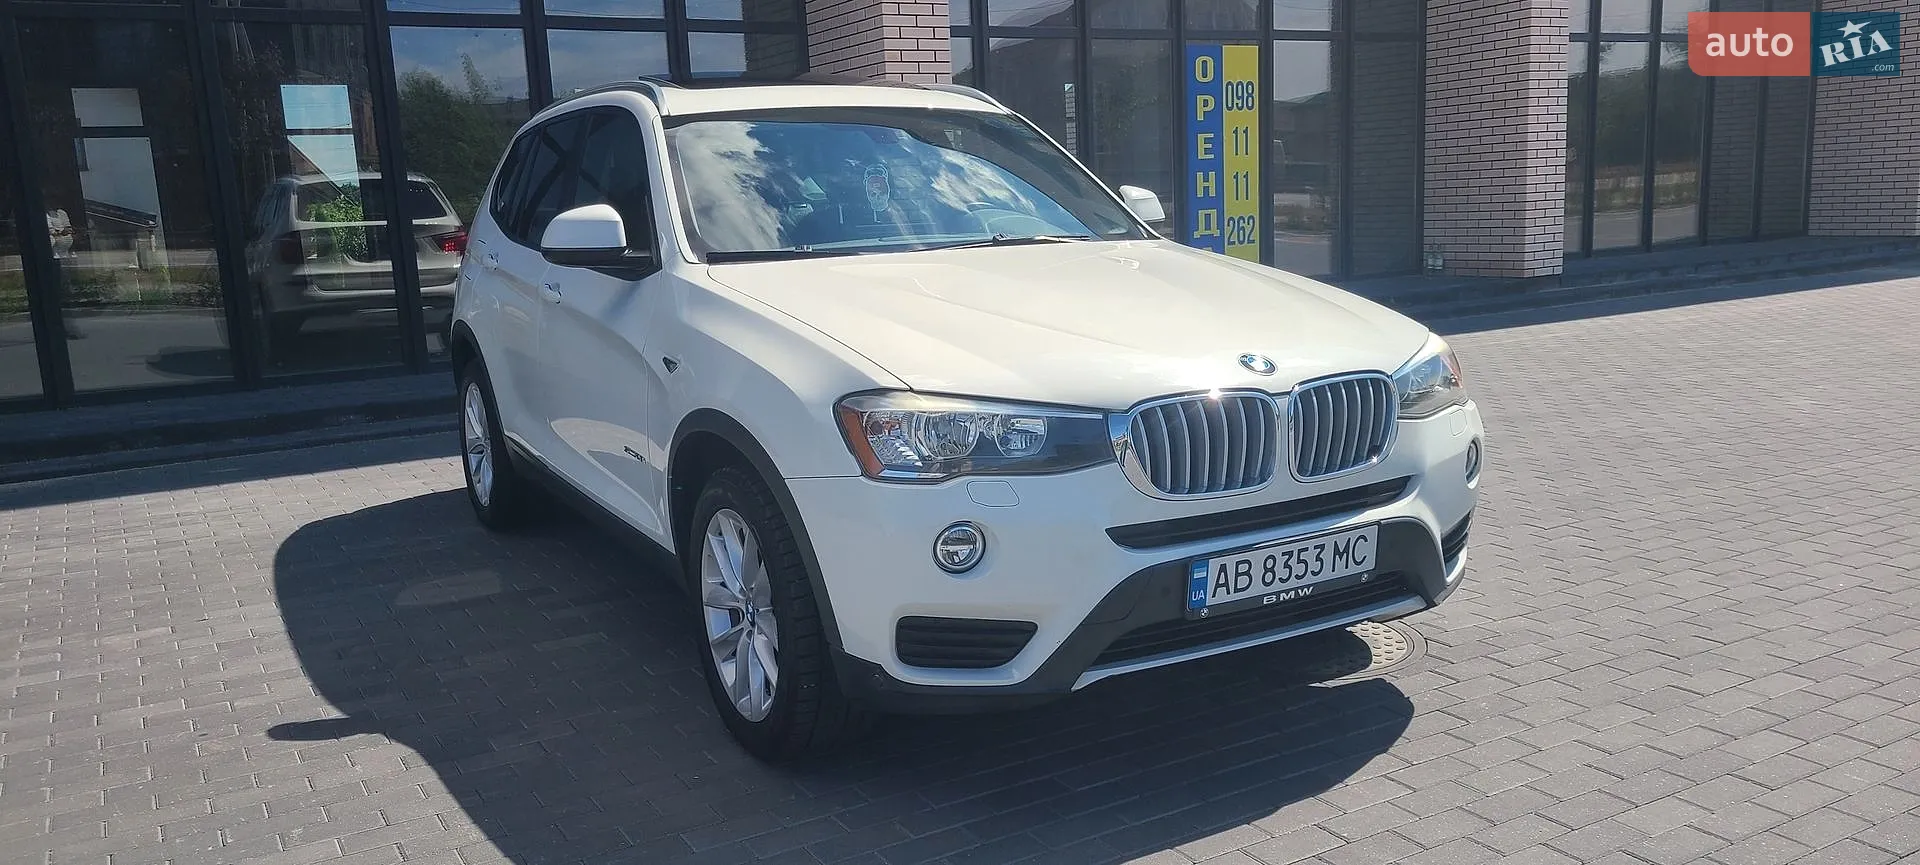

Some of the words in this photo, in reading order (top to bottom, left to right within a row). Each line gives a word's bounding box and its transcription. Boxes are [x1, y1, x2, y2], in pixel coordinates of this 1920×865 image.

[1225, 80, 1255, 111] 098
[1194, 55, 1221, 252] ОРЕНД
[1232, 126, 1249, 156] 11
[1233, 171, 1249, 201] 11
[1227, 215, 1256, 246] 262
[1211, 559, 1253, 599] AB
[1261, 543, 1326, 587] 8353
[1331, 534, 1369, 573] MC
[1192, 589, 1205, 601] UA
[1263, 586, 1314, 605] BMW
